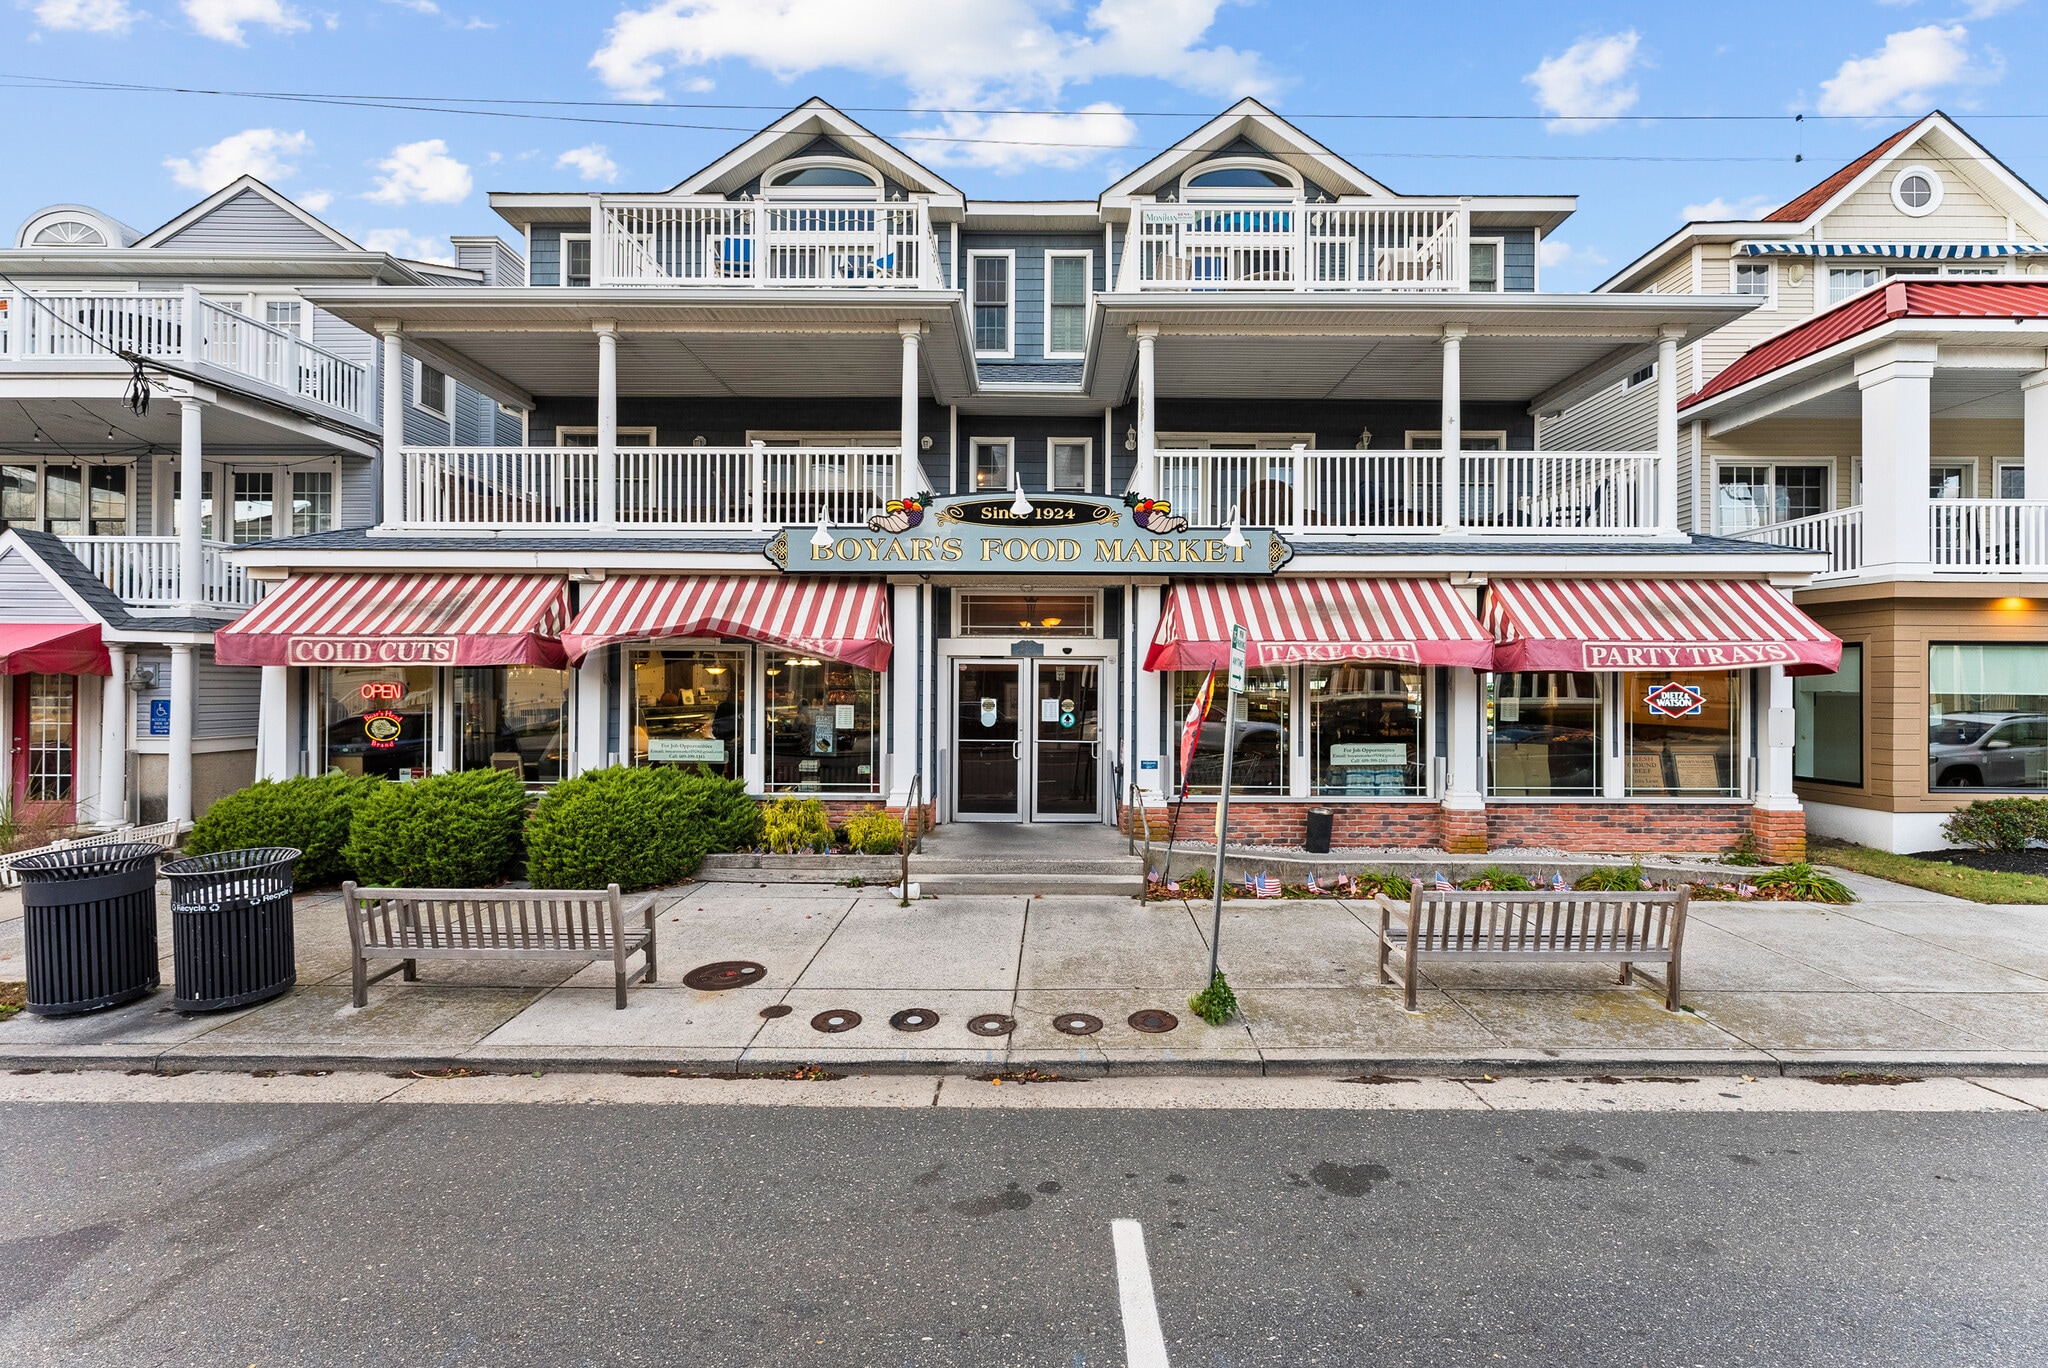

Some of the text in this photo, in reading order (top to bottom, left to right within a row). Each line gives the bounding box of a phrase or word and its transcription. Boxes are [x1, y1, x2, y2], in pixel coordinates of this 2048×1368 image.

[1035, 507, 1075, 519] 1924
[811, 537, 1251, 562] BOYAR'S FOOD MARKET
[296, 641, 450, 661] COLD CUTS
[1265, 645, 1409, 662] TAKE OUT
[1590, 644, 1788, 666] PARTY TRAYS
[361, 684, 402, 699] OPEN
[364, 710, 403, 722] Boar's Head
[263, 888, 290, 902] Recycle
[176, 903, 207, 913] Recycle
